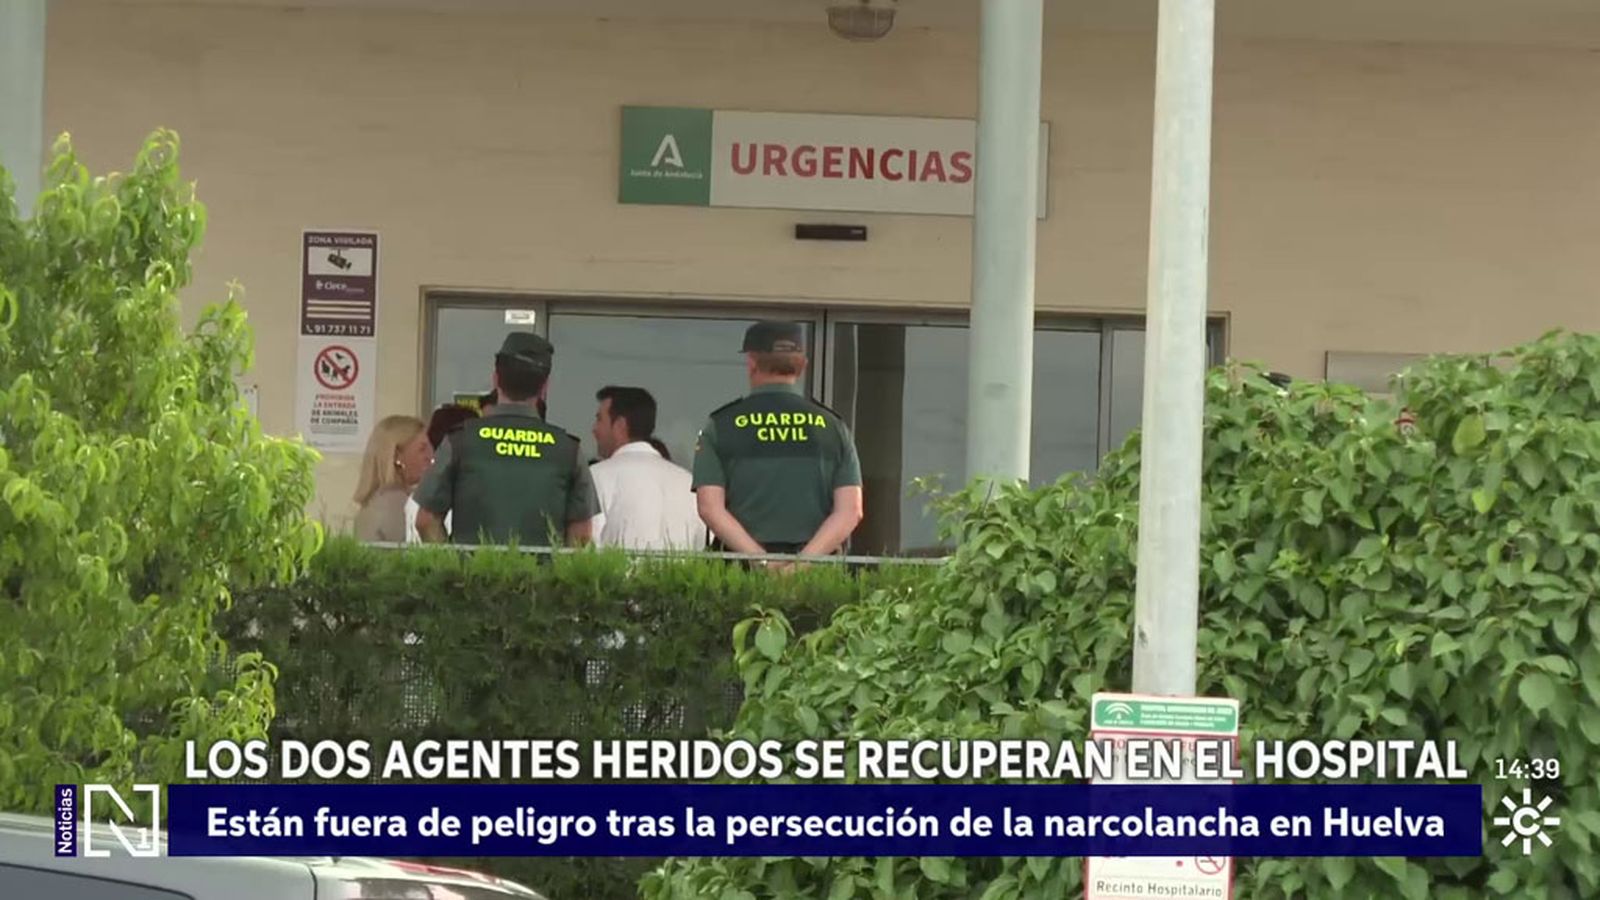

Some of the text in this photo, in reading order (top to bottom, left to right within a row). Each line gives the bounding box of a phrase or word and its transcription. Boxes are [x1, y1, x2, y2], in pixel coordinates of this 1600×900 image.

[730, 141, 973, 185] URGENCIAS
[308, 236, 373, 245] ZONA VIGILADA
[314, 324, 372, 335] 91 737 11 71
[735, 411, 826, 430] GUARDIA
[479, 426, 556, 446] GUARDIA
[757, 428, 809, 443] CIVIL
[495, 442, 542, 459] CIVIL
[1096, 880, 1223, 898] Recinto Hospitalario
